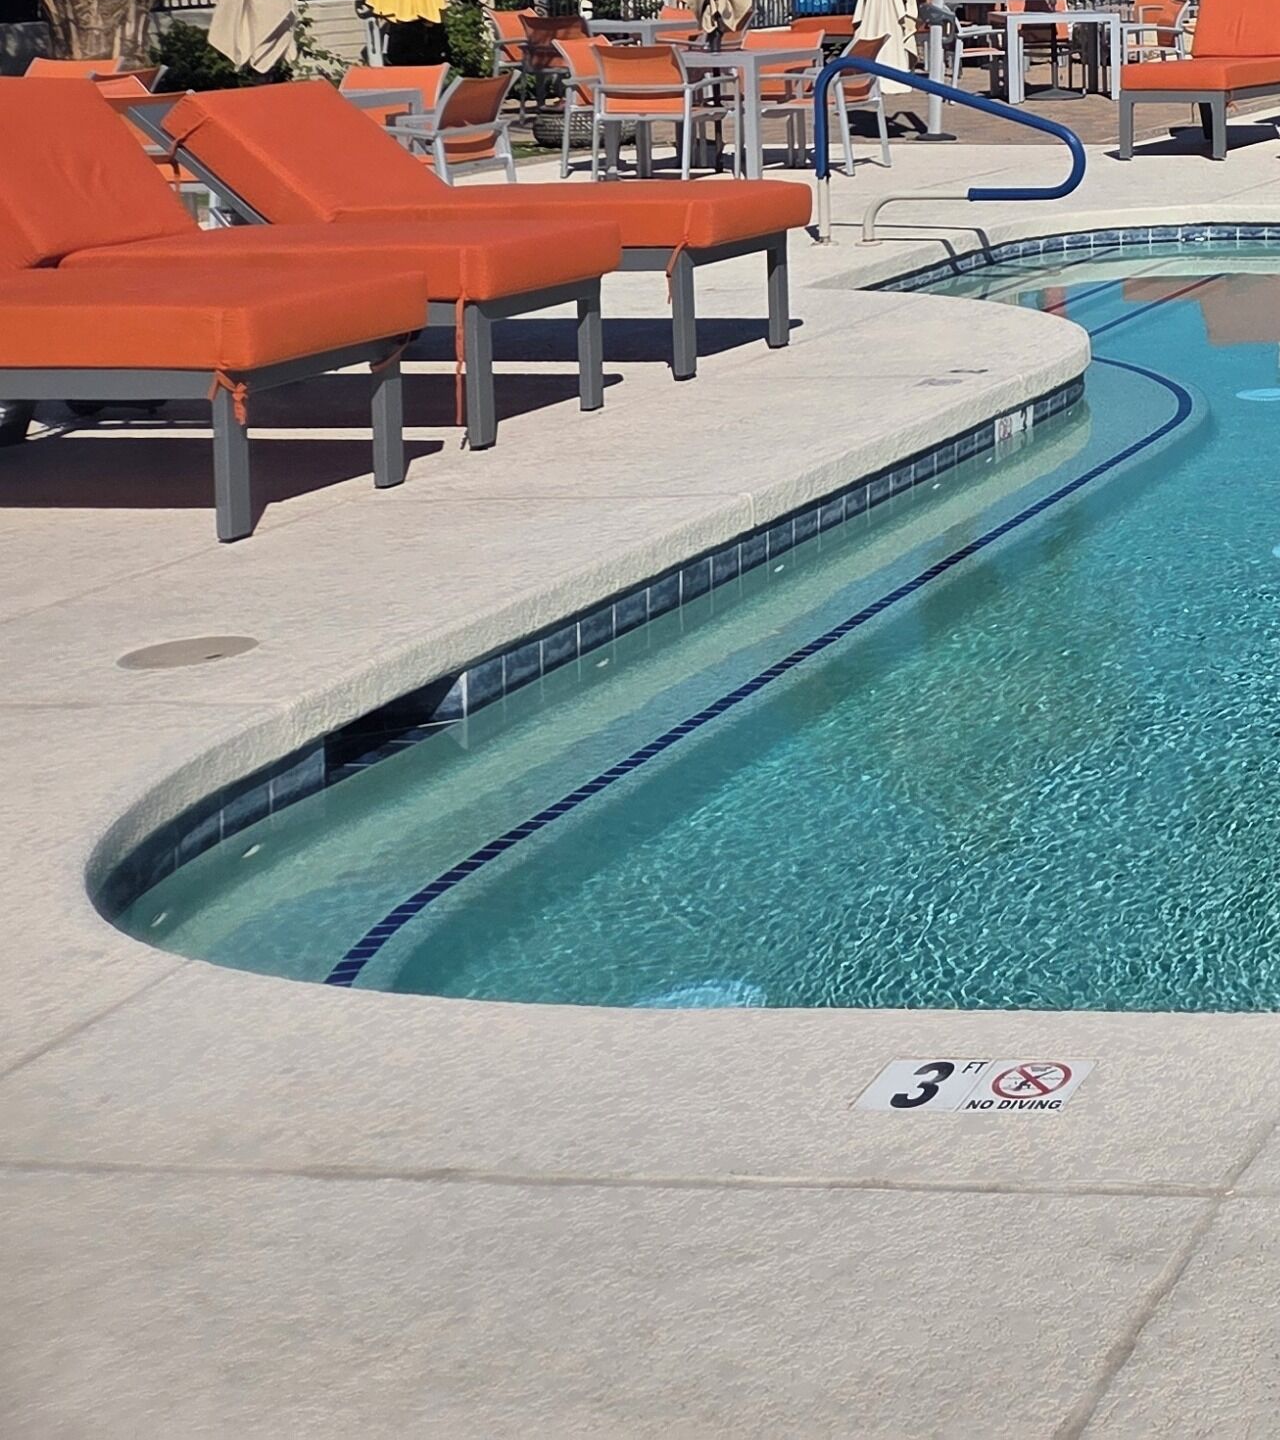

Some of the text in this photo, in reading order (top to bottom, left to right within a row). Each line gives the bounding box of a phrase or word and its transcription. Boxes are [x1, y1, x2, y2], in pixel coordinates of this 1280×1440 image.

[890, 1061, 989, 1108] 3 FT
[965, 1099, 1063, 1110] NO DIVING
